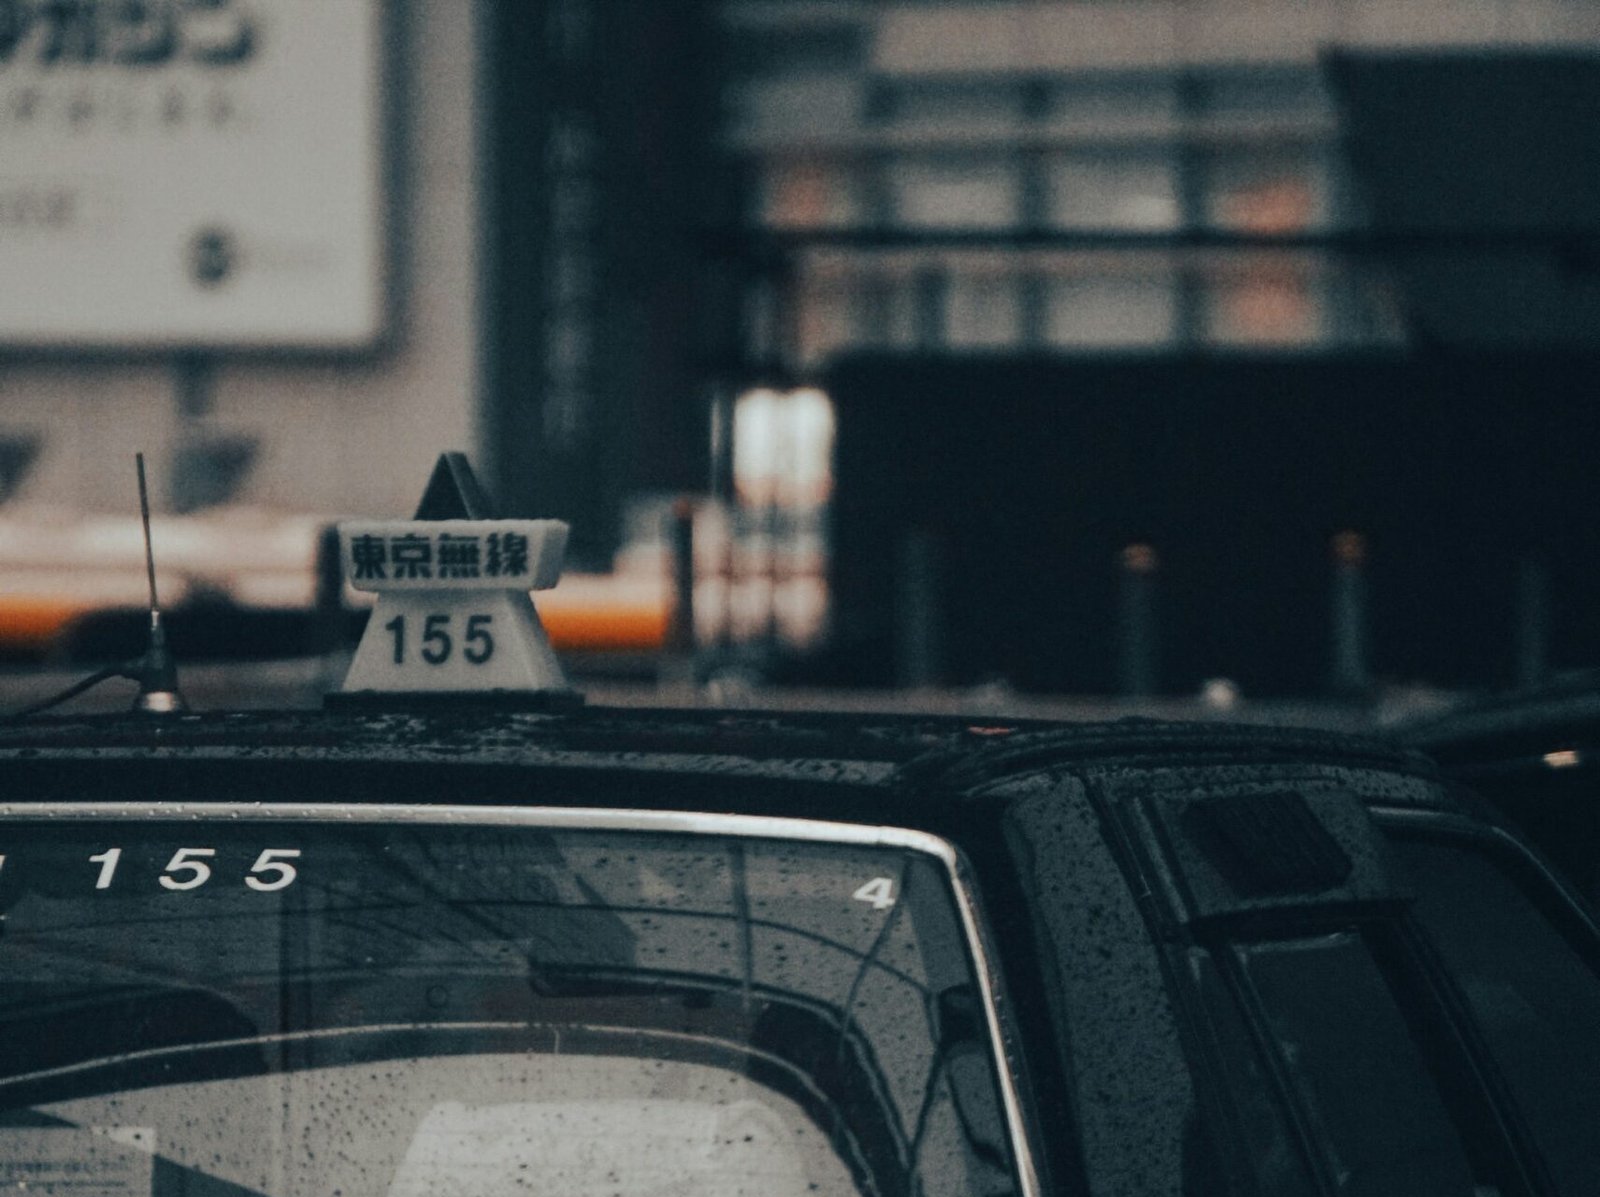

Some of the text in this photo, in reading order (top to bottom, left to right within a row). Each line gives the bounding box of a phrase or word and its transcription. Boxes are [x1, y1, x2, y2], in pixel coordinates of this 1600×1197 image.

[351, 532, 528, 579] 東京無線
[385, 614, 495, 665] 155
[89, 848, 301, 891] 155
[852, 877, 896, 909] 4
